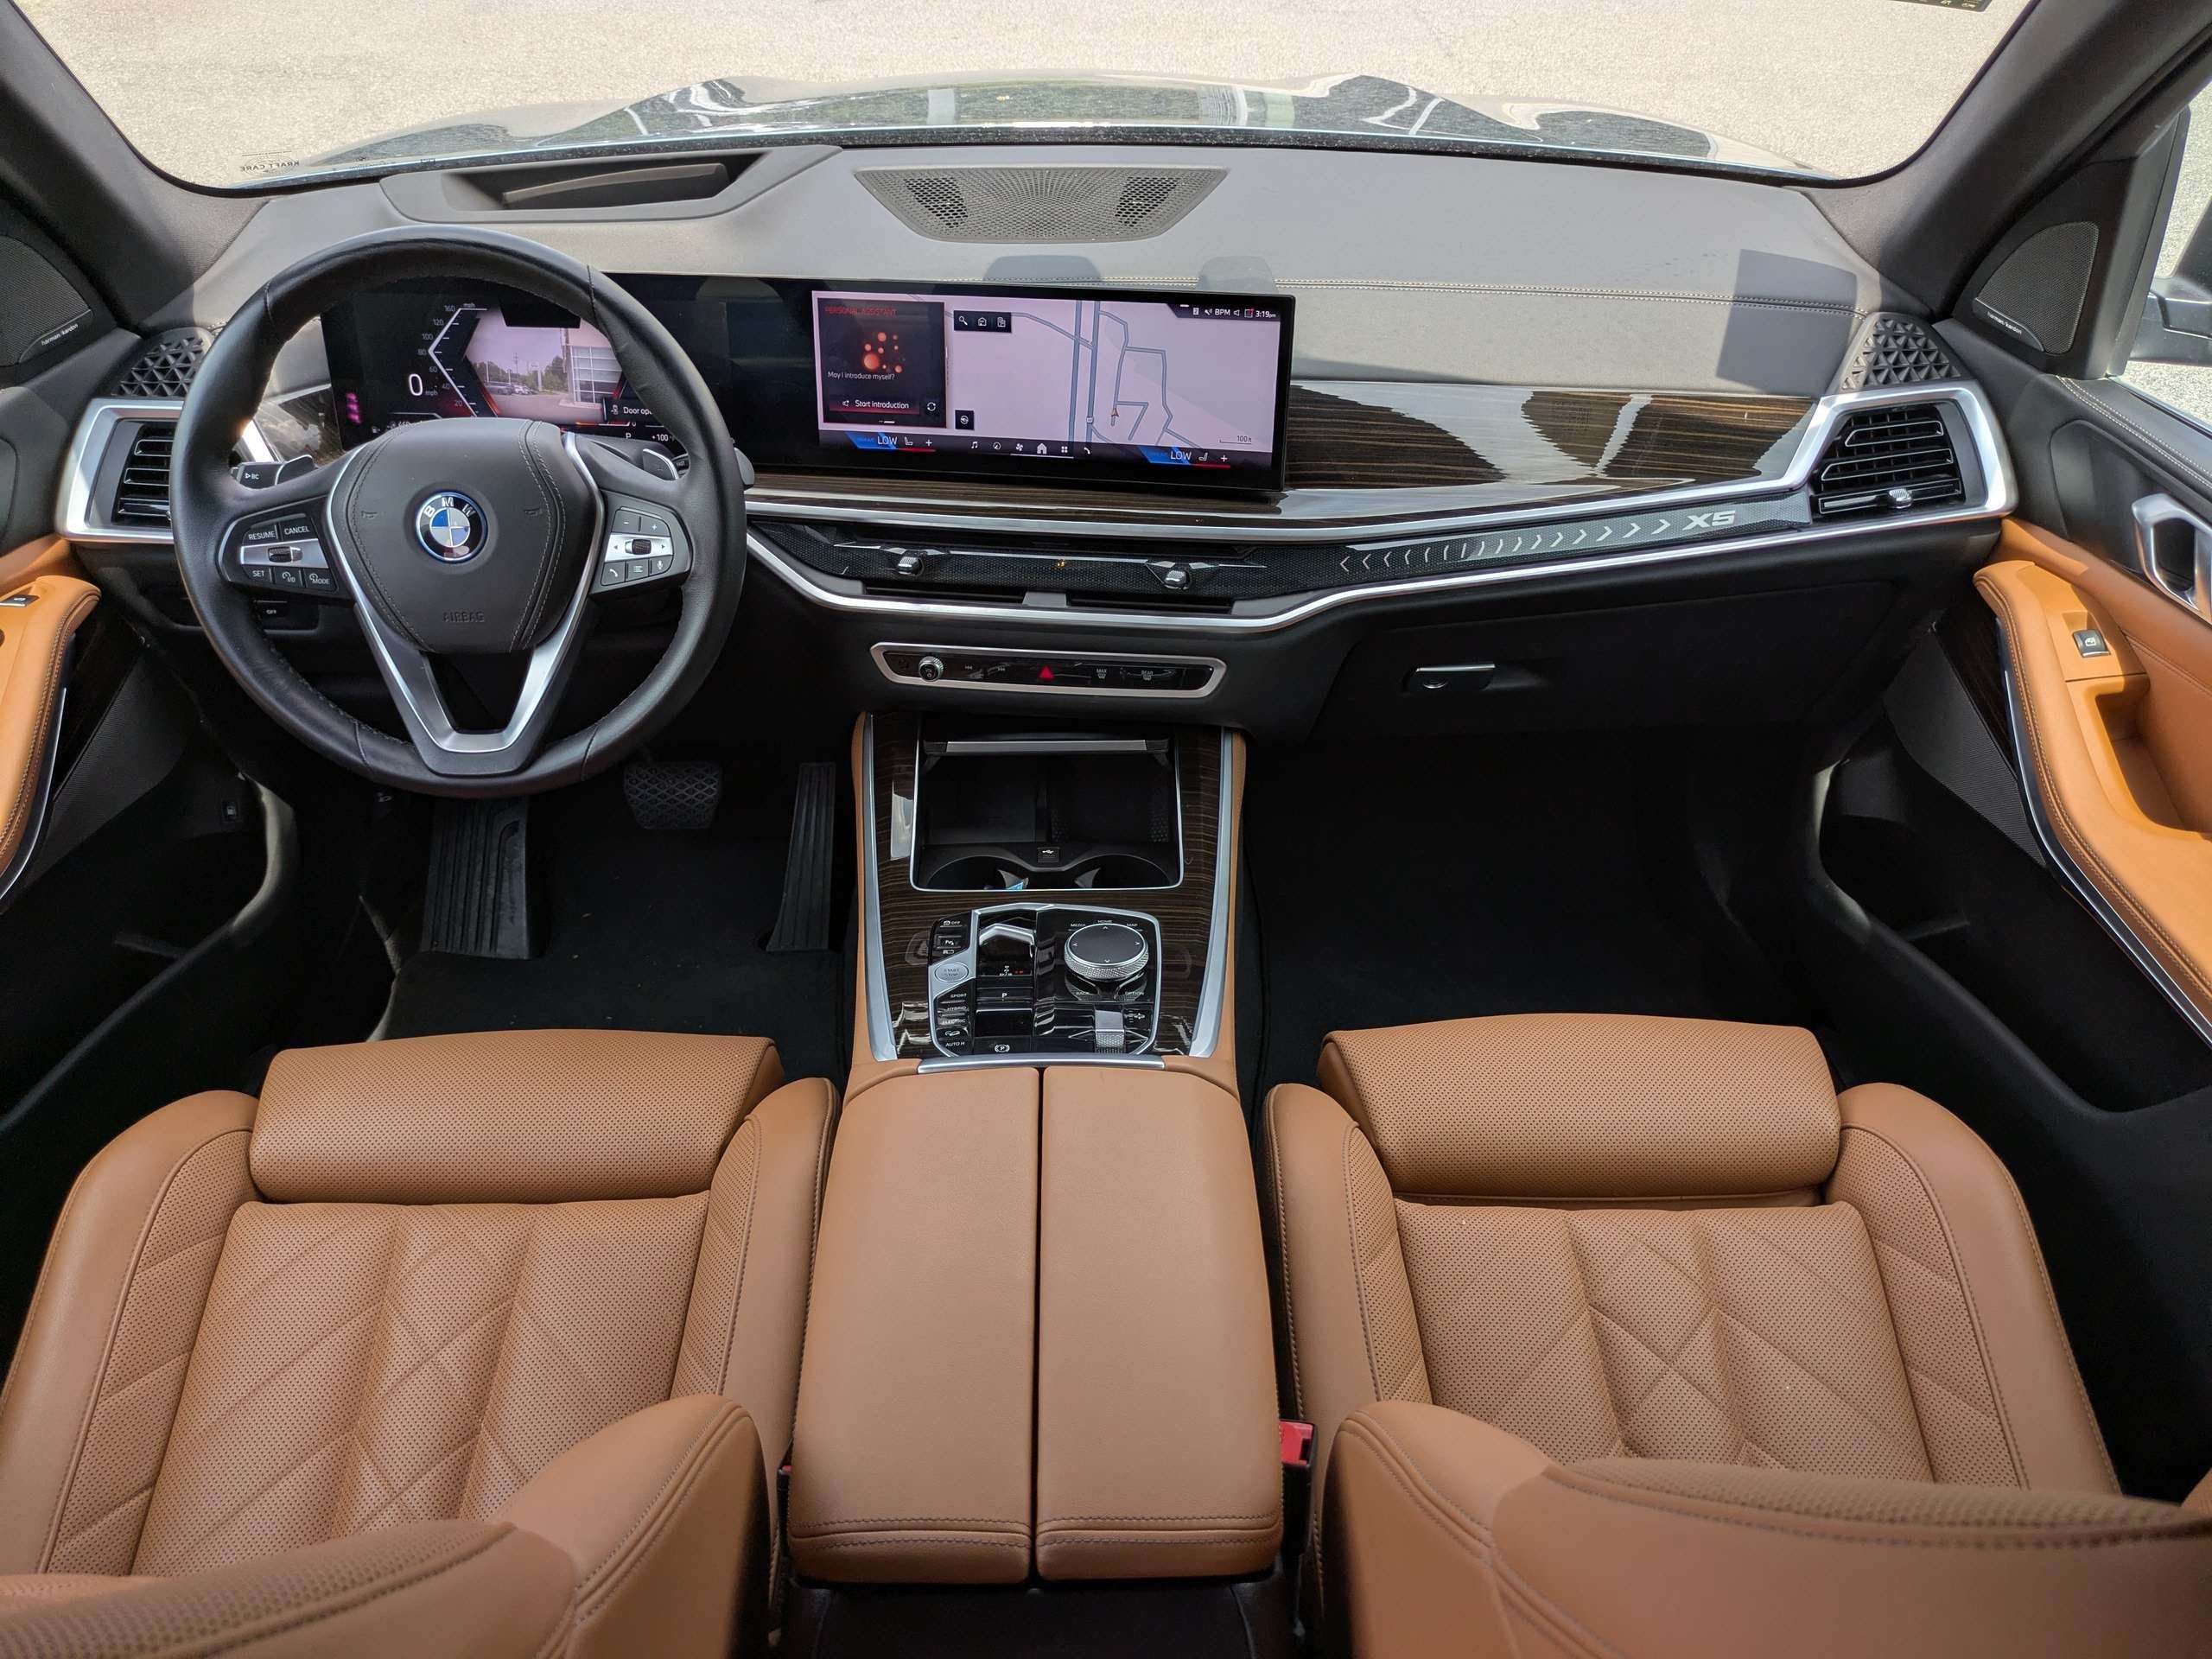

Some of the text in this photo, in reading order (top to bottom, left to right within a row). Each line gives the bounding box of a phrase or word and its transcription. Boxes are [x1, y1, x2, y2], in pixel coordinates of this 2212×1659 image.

[828, 371, 841, 379] May
[845, 372, 872, 380] introduce
[409, 373, 423, 396] 0
[855, 399, 910, 409] Start introduction
[623, 406, 640, 415] Door
[877, 435, 898, 445] LOW
[1170, 450, 1192, 461] LOW
[423, 496, 476, 518] BMW
[1682, 510, 1736, 531] X5
[283, 525, 311, 536] CANCEL
[248, 531, 276, 541] RESUME
[252, 569, 264, 578] SET
[442, 611, 485, 623] AIRBAG
